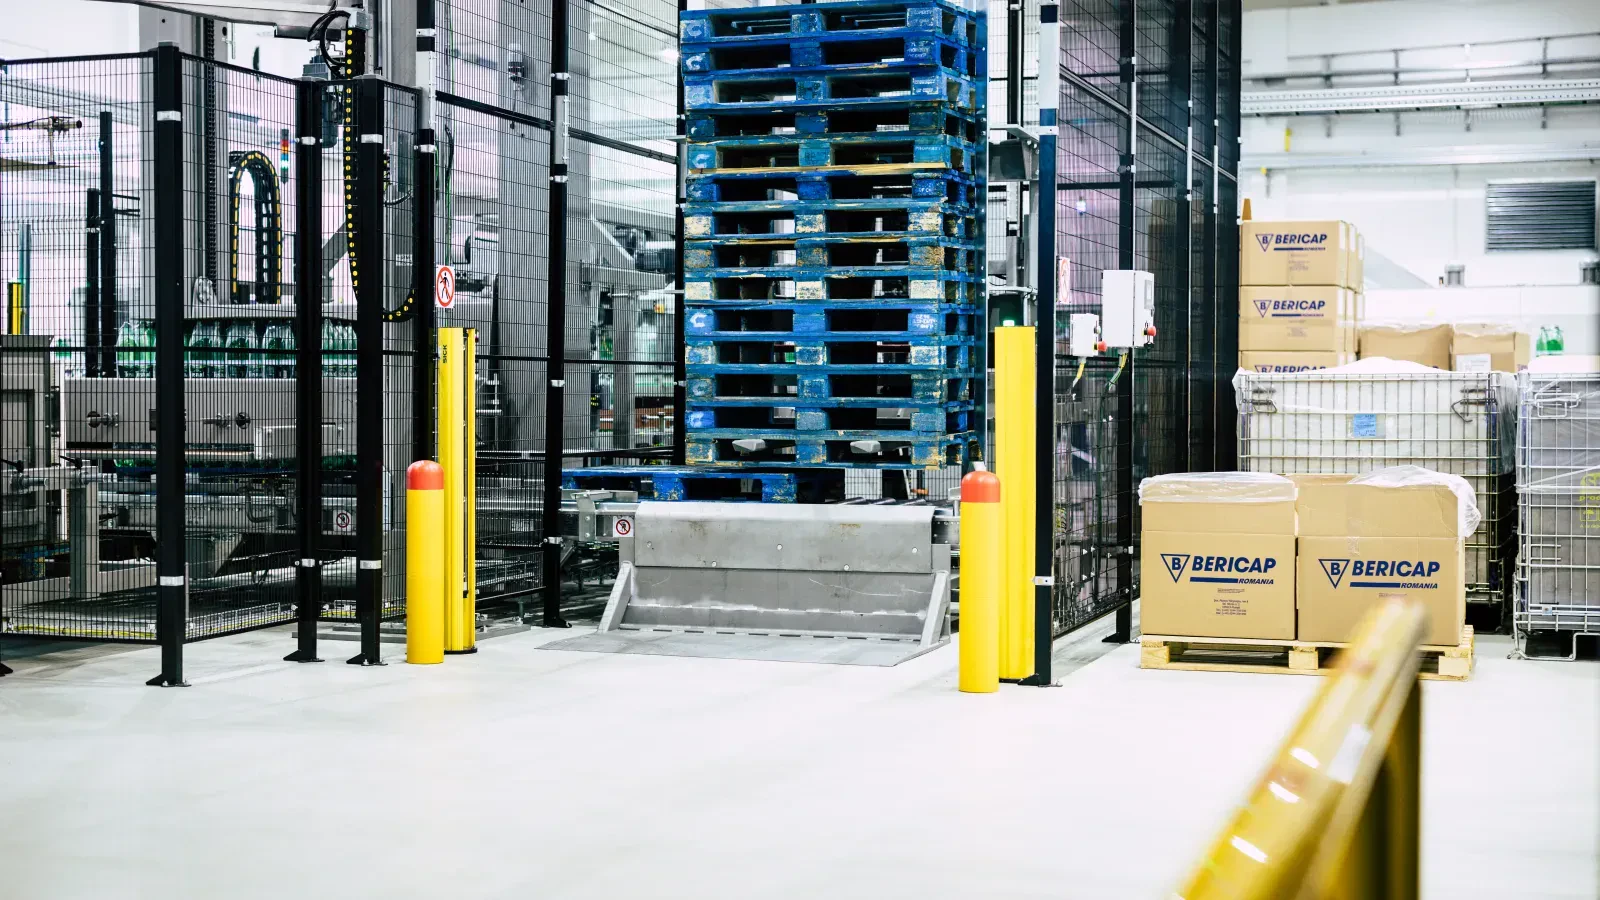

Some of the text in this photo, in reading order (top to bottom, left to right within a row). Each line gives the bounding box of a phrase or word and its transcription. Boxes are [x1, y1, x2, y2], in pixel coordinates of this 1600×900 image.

[1275, 234, 1327, 244] BERICAP
[1273, 300, 1326, 310] BERICAP
[1192, 556, 1277, 573] BERICAP
[1352, 561, 1440, 577] BERICAP
